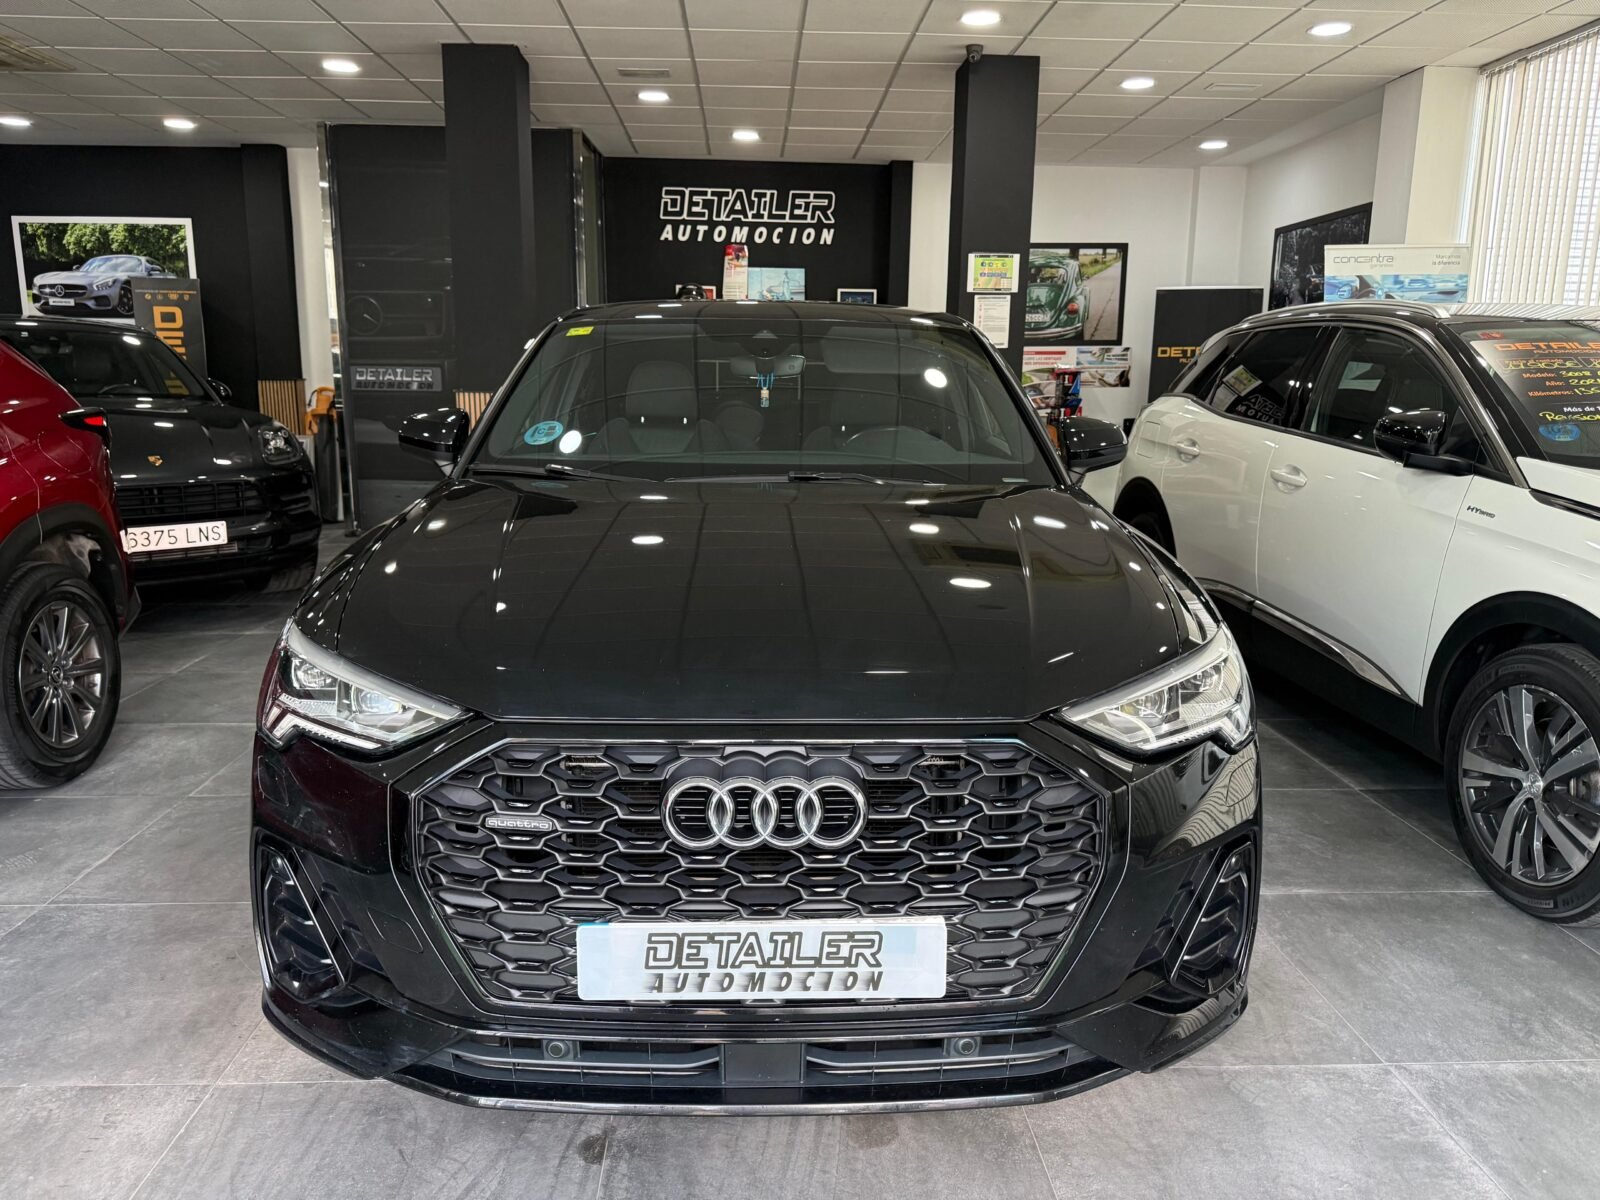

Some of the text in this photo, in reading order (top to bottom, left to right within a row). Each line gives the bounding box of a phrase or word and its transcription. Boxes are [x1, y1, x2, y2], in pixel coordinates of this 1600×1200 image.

[660, 187, 836, 223] DETAILER
[660, 224, 835, 245] AUTOMOCION
[356, 368, 433, 381] DETAILER
[1466, 505, 1496, 519] HYBRID
[186, 525, 220, 544] LNS
[488, 819, 549, 829] quattro
[645, 931, 883, 969] DETAILER
[649, 971, 883, 993] AUTOMOCION
